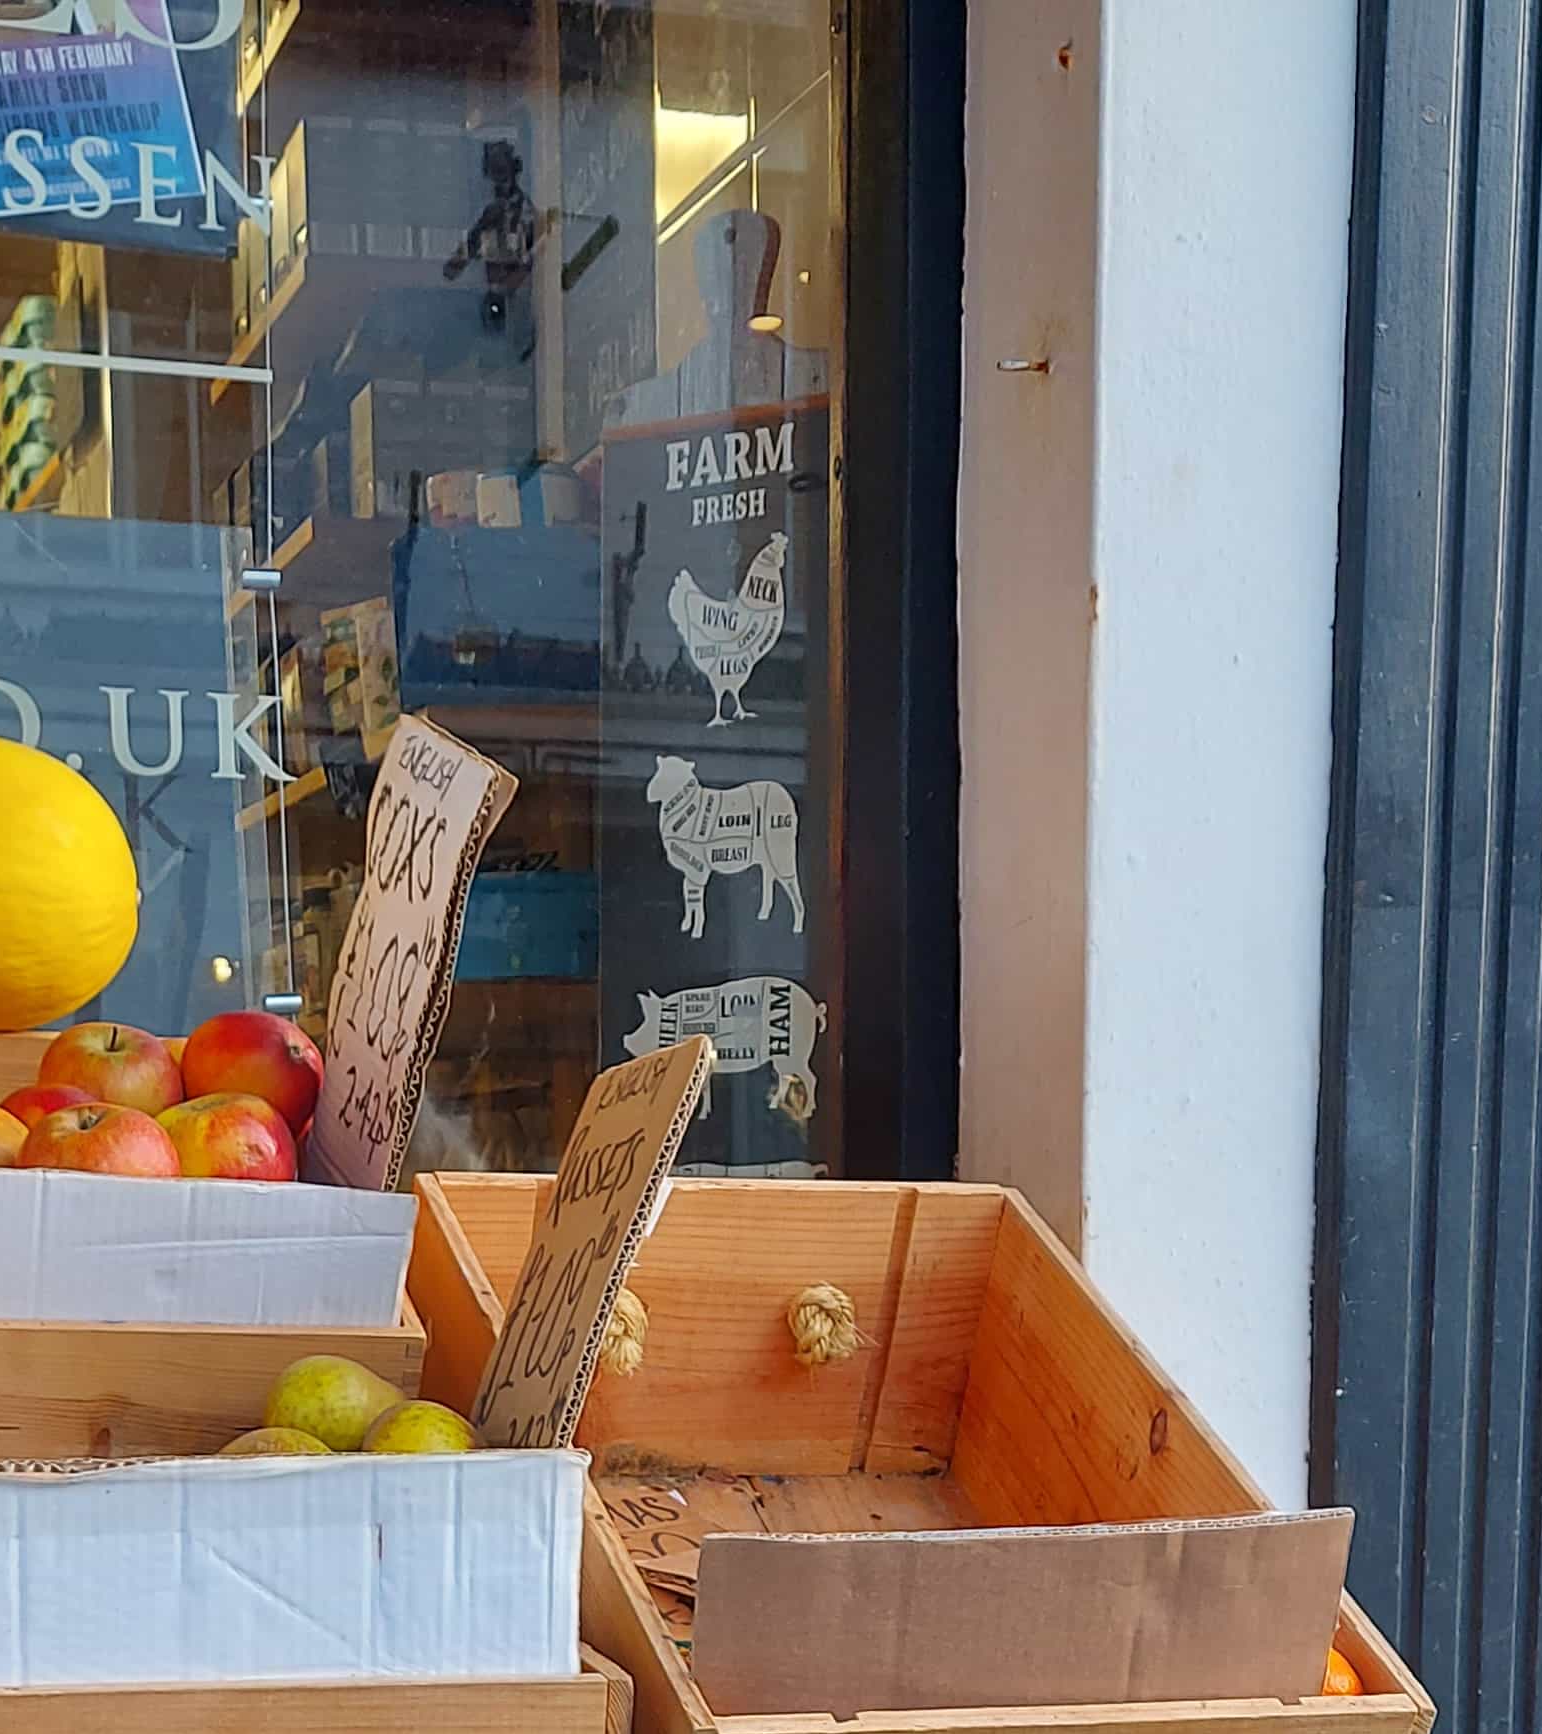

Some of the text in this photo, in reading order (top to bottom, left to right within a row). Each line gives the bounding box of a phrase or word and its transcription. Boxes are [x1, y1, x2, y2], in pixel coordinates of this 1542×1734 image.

[24, 47, 56, 72] 4TH
[59, 41, 134, 71] FEBRUARY
[58, 73, 109, 104] SHOW
[65, 101, 161, 137] WORKSHOP
[665, 421, 795, 492] FARM
[691, 487, 767, 527] FRESH
[745, 575, 780, 604] NECK
[701, 604, 739, 632] WING
[397, 734, 464, 801] ENGLISH
[718, 813, 752, 829] LOIN
[770, 814, 793, 830] LEG
[368, 781, 448, 904] COXS
[711, 847, 749, 864] BREAST
[768, 984, 792, 1057] HAM
[717, 1047, 757, 1060] BELLY
[547, 1126, 646, 1228] RUSSETS
